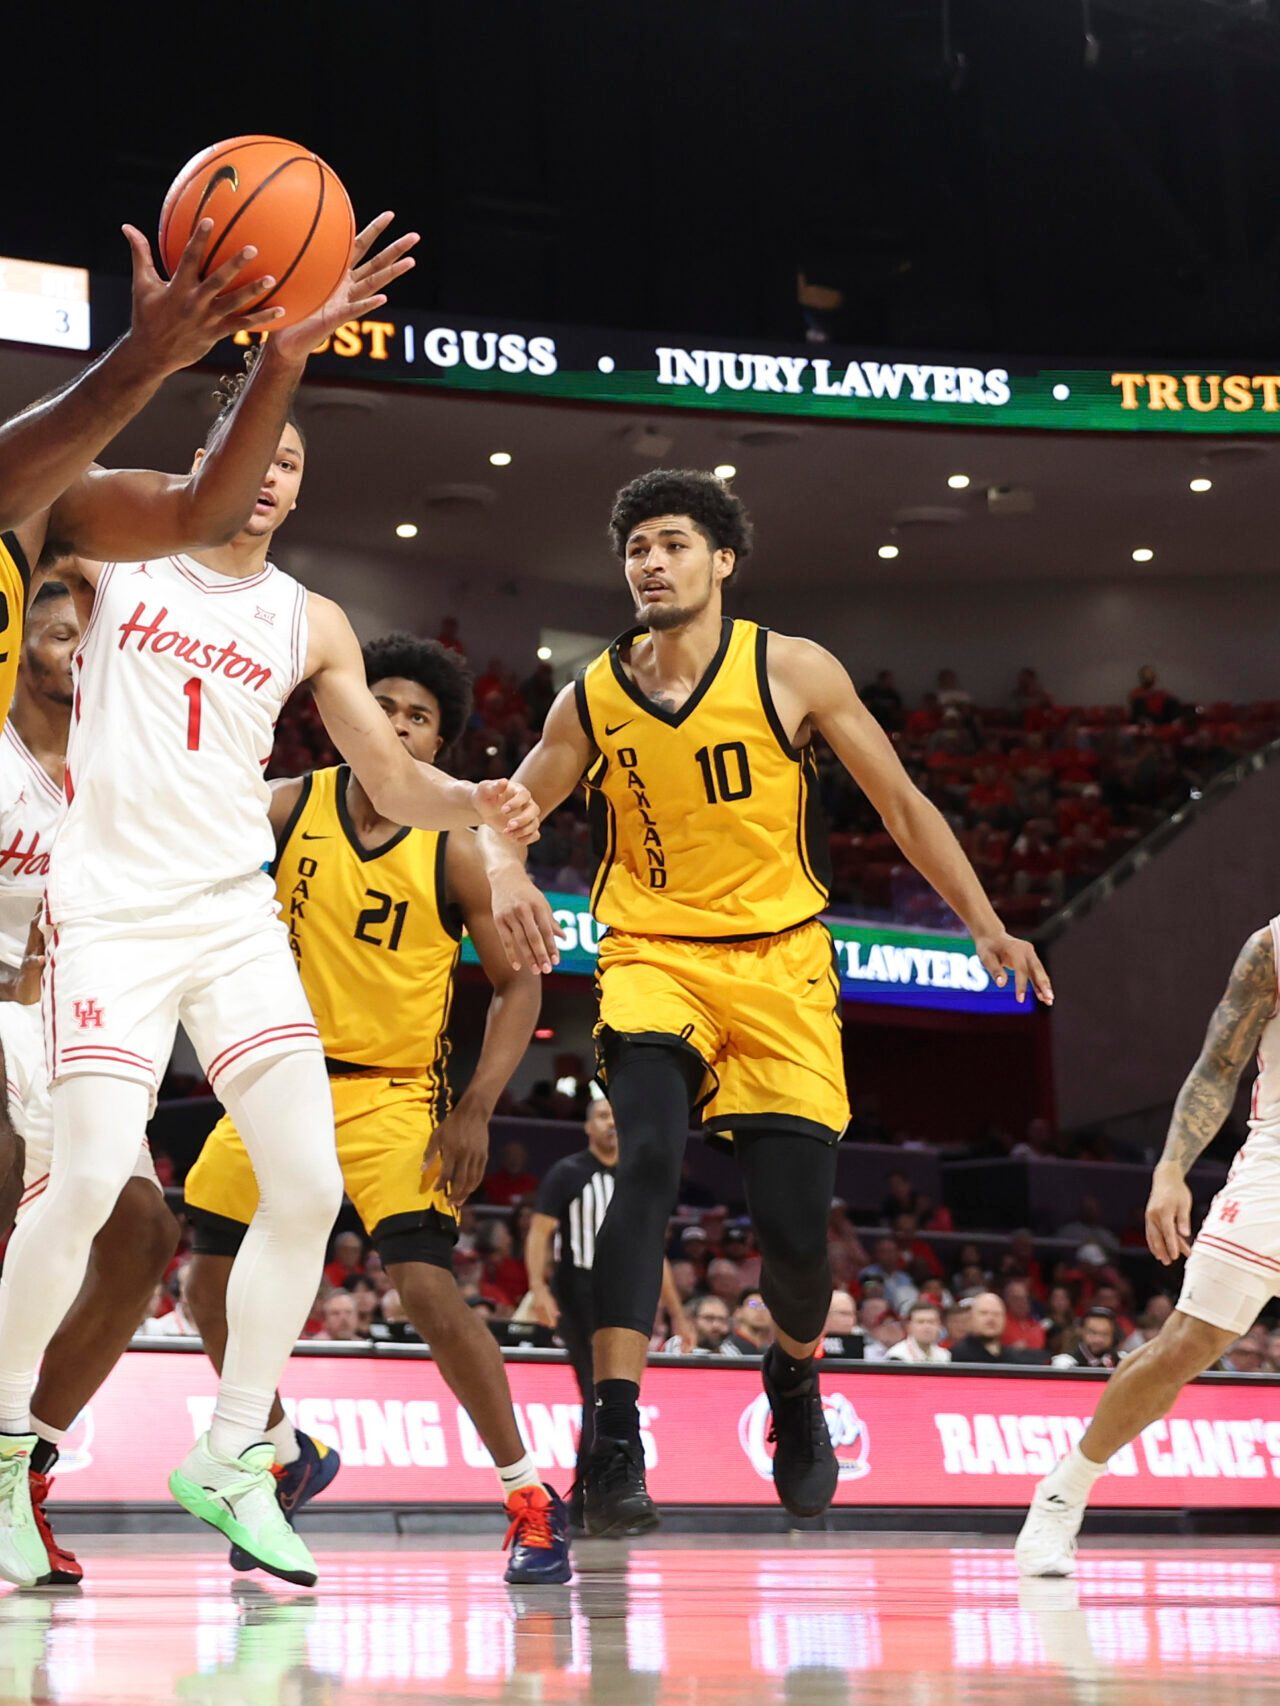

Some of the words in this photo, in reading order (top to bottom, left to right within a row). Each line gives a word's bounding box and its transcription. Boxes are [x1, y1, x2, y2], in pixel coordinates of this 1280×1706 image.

[56, 310, 71, 334] 3
[424, 327, 557, 375] GUSS
[656, 347, 808, 394] INJURY
[813, 358, 1011, 405] LAWYERS
[118, 600, 272, 693] Houston
[182, 676, 202, 752] 1
[694, 741, 753, 804] 10
[616, 747, 668, 889] OAKLAND
[289, 856, 318, 974] OAKLA
[354, 888, 409, 952] 21
[845, 941, 990, 992] LAWYERS
[73, 999, 104, 1029] UH
